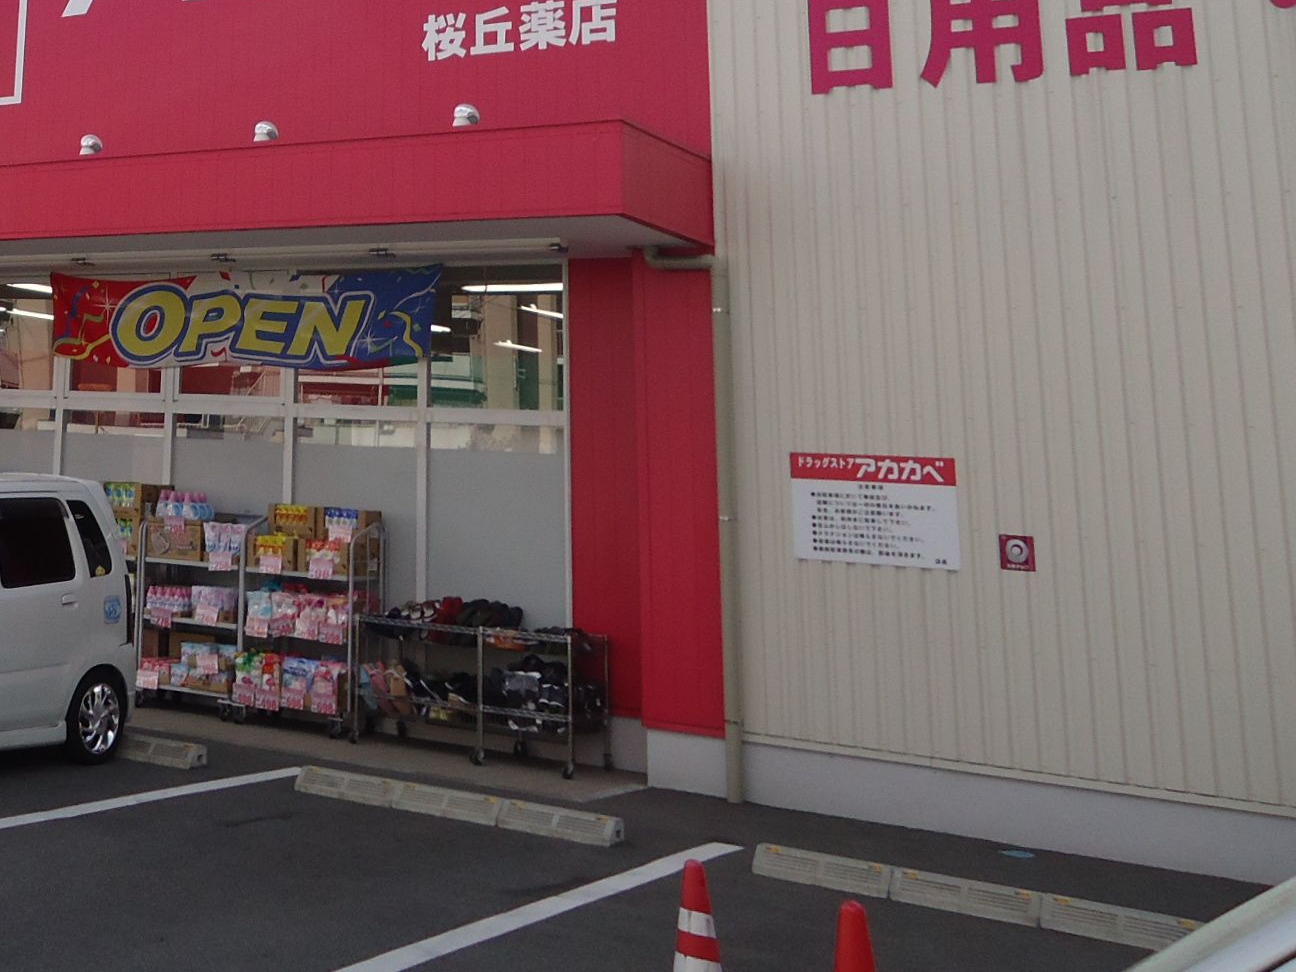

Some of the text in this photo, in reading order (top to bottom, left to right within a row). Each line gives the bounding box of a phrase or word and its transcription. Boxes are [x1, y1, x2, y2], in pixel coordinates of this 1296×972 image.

[115, 284, 369, 361] OPEN
[798, 456, 945, 482] ドラッグストア アカカベ
